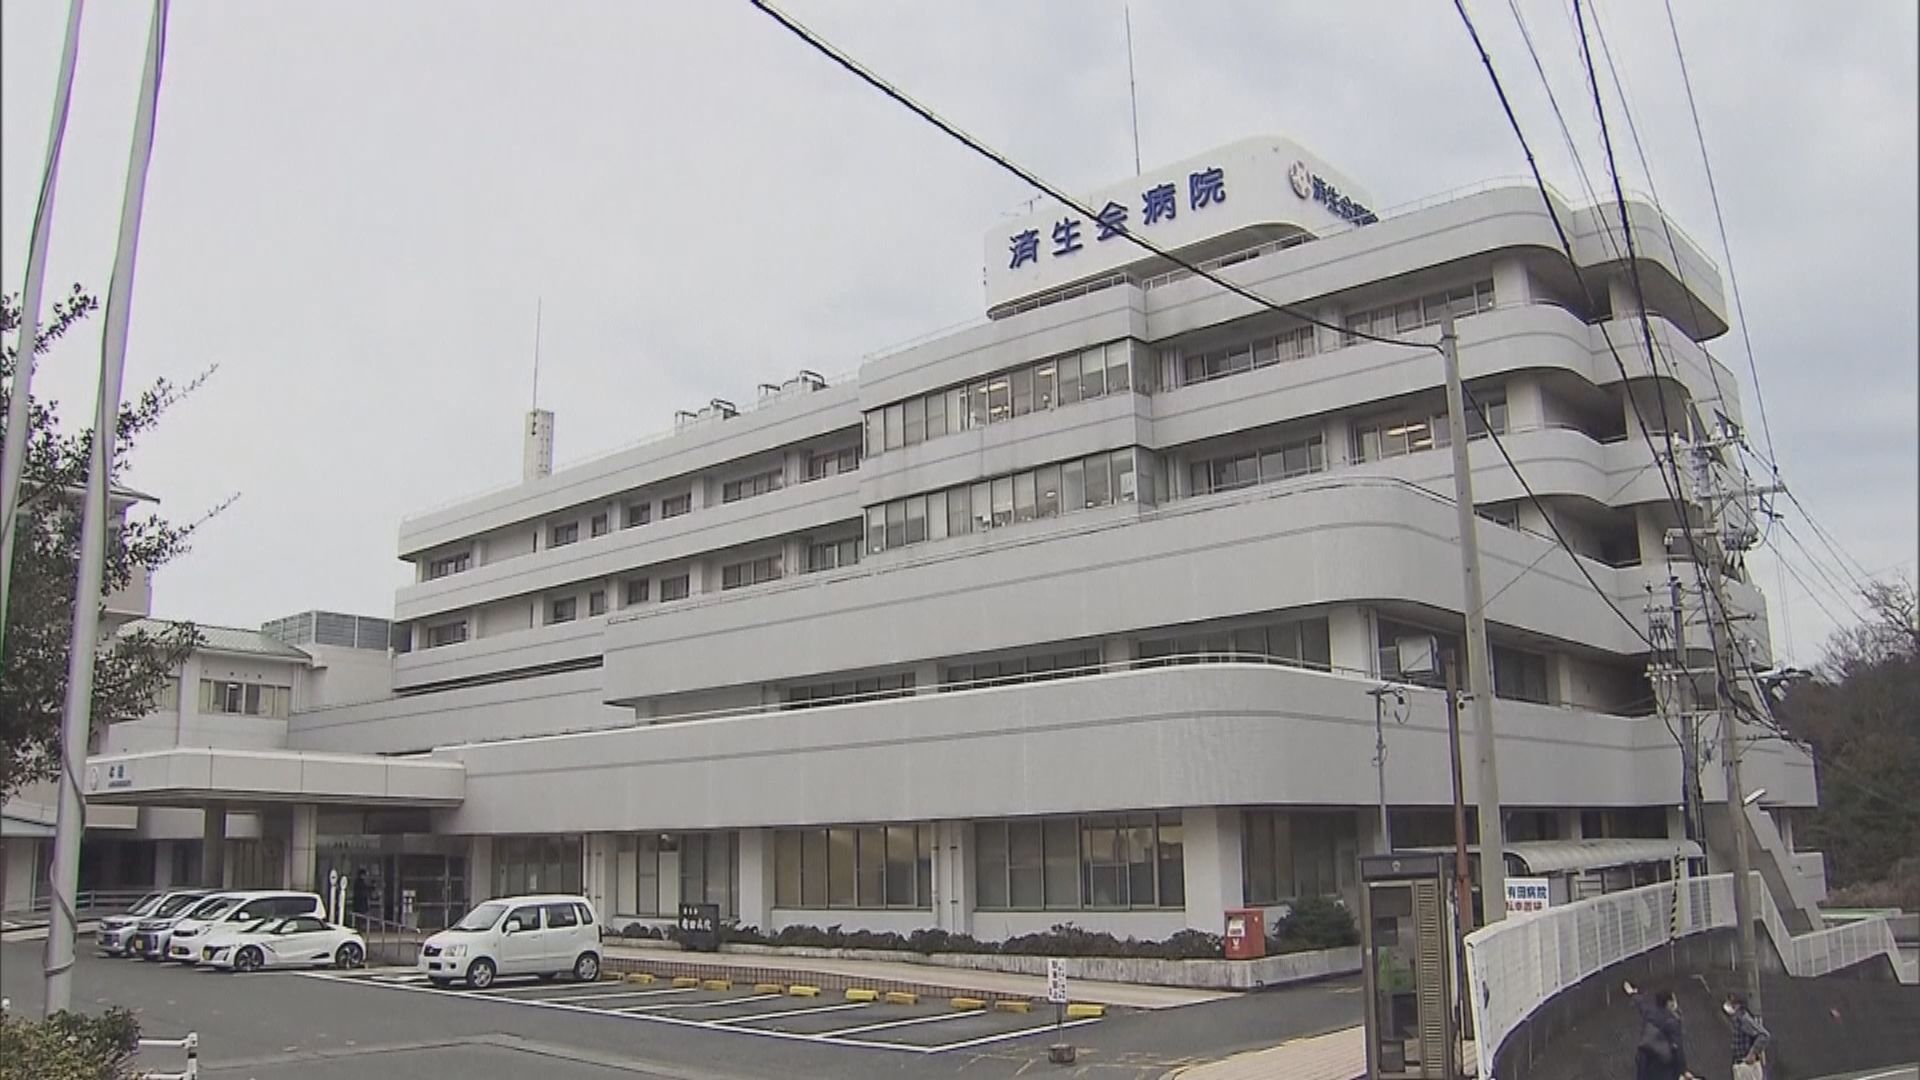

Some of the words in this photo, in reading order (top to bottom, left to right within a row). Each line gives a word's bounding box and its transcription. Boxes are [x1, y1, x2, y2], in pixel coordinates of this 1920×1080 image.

[1009, 167, 1226, 269] 済生会病院
[1506, 886, 1547, 899] 有田病院
